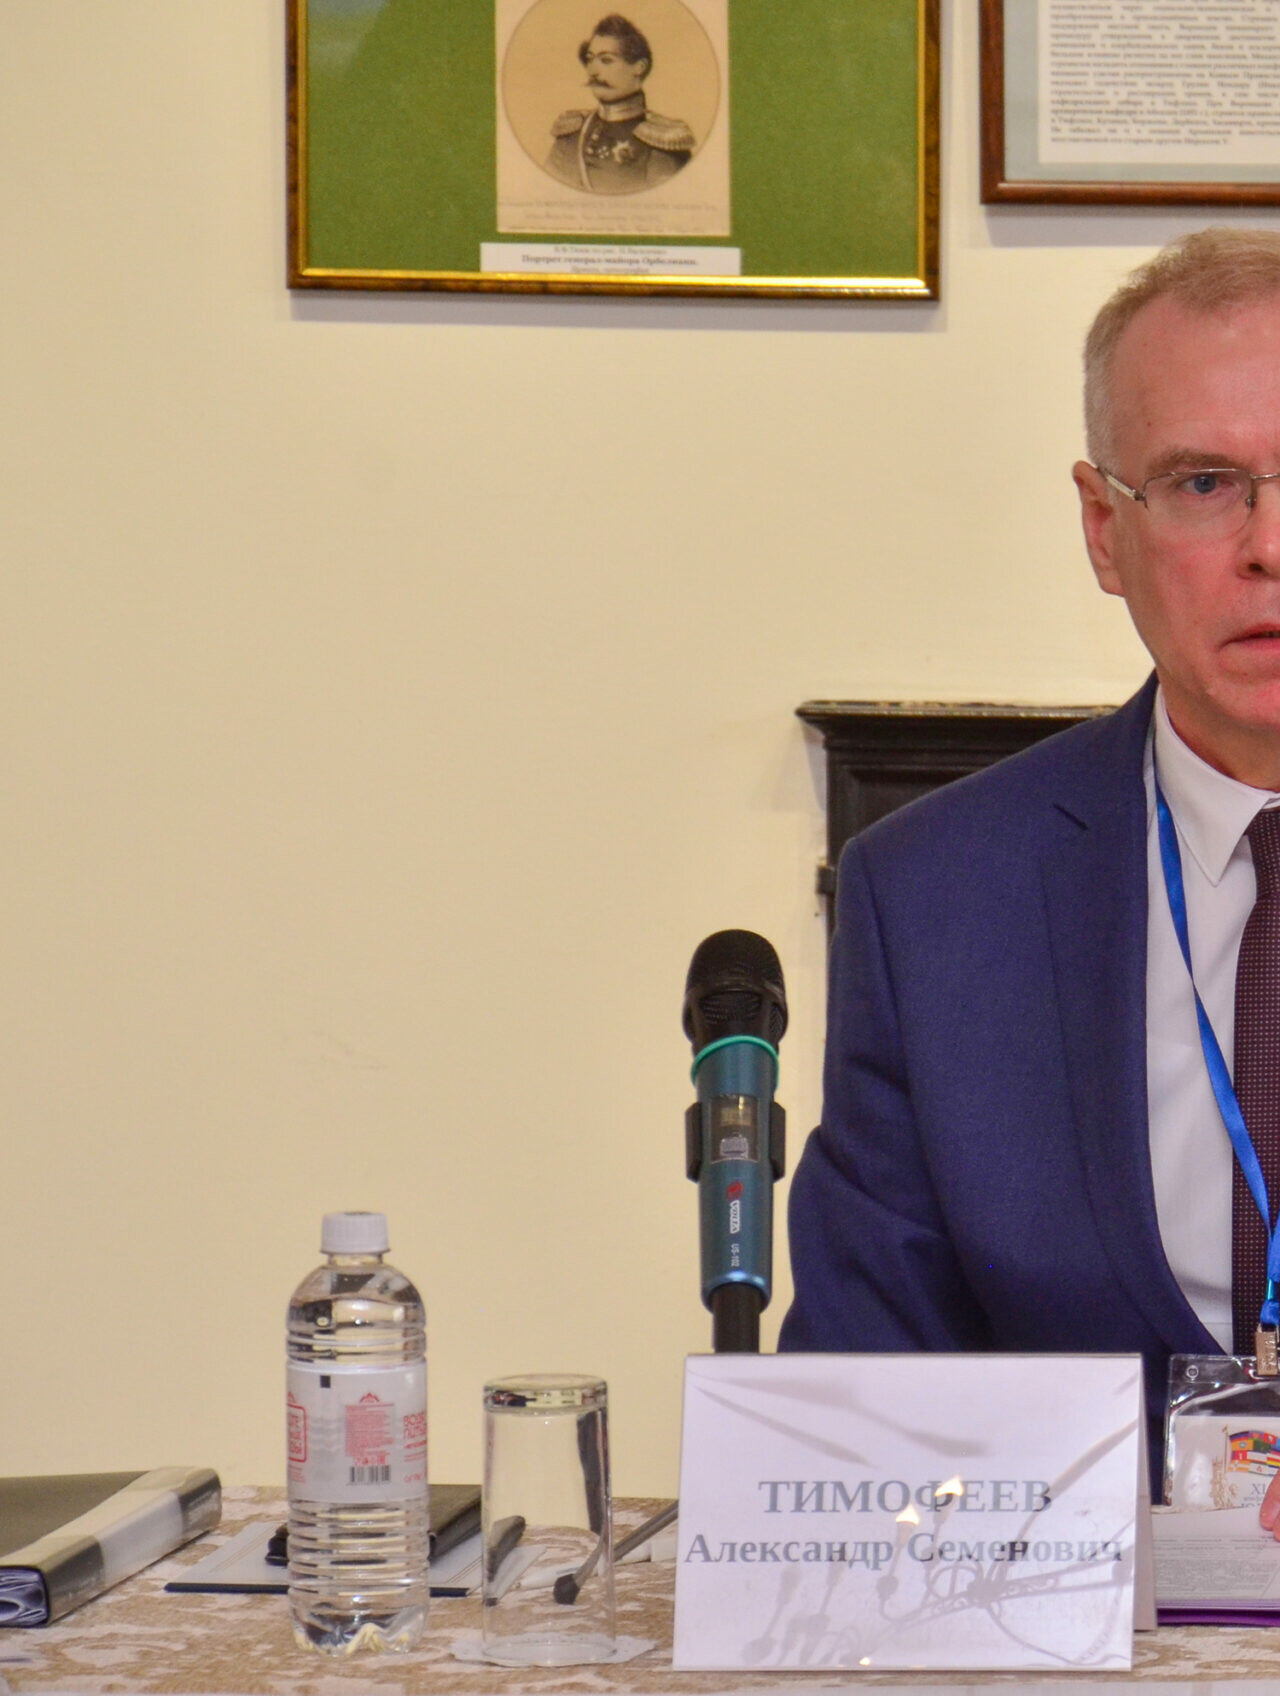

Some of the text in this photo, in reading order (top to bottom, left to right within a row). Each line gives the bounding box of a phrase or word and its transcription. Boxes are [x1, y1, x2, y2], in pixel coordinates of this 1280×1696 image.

[758, 1479, 1053, 1514] ТИМОФЕЕВ
[684, 1532, 1124, 1571] Александр Семенович
